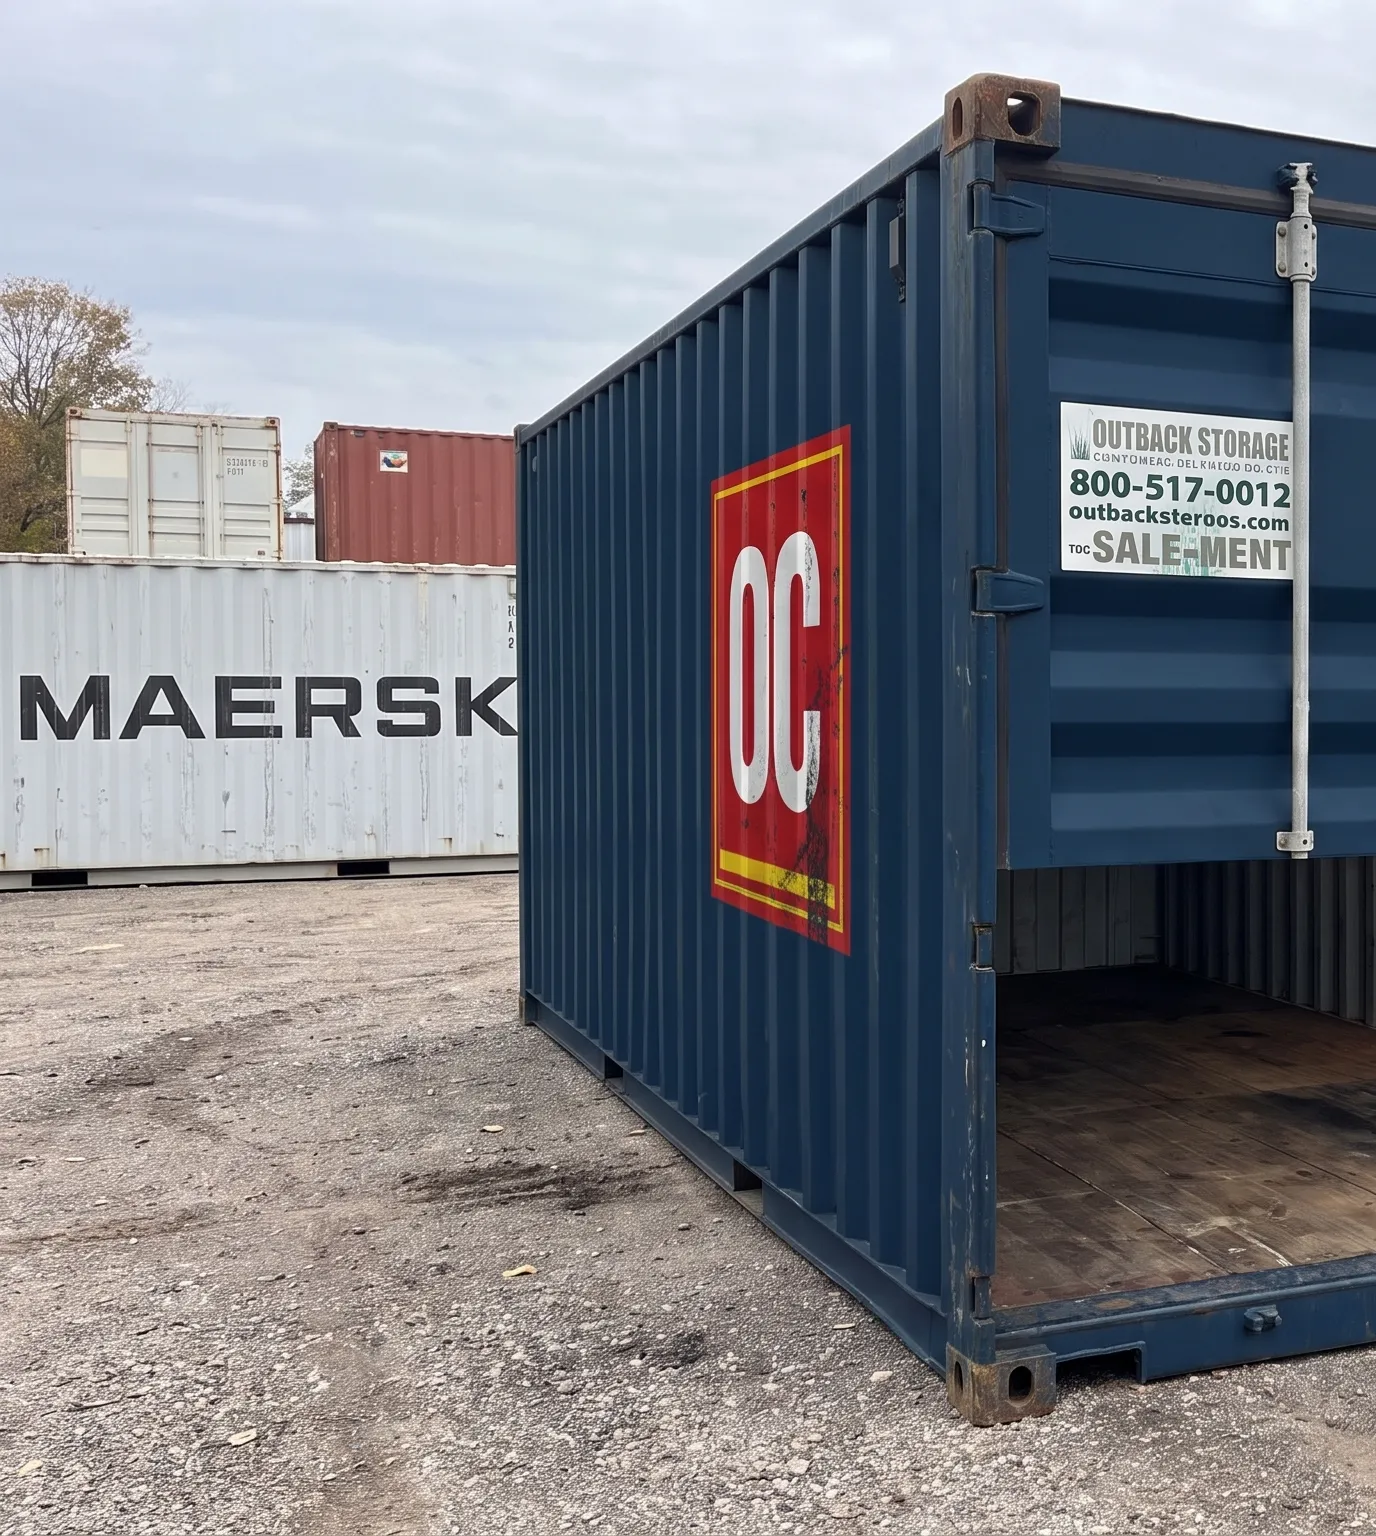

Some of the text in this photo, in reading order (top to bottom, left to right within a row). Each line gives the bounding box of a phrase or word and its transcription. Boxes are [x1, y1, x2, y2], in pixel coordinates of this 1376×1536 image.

[1093, 418, 1290, 462] OUTBACK STORAGE
[1069, 469, 1291, 508] 800-517-0012
[1069, 503, 1290, 531] outbacksteroos.com
[1092, 530, 1292, 571] SALE-MENT
[729, 530, 821, 814] OC
[19, 675, 518, 741] MAERSK
